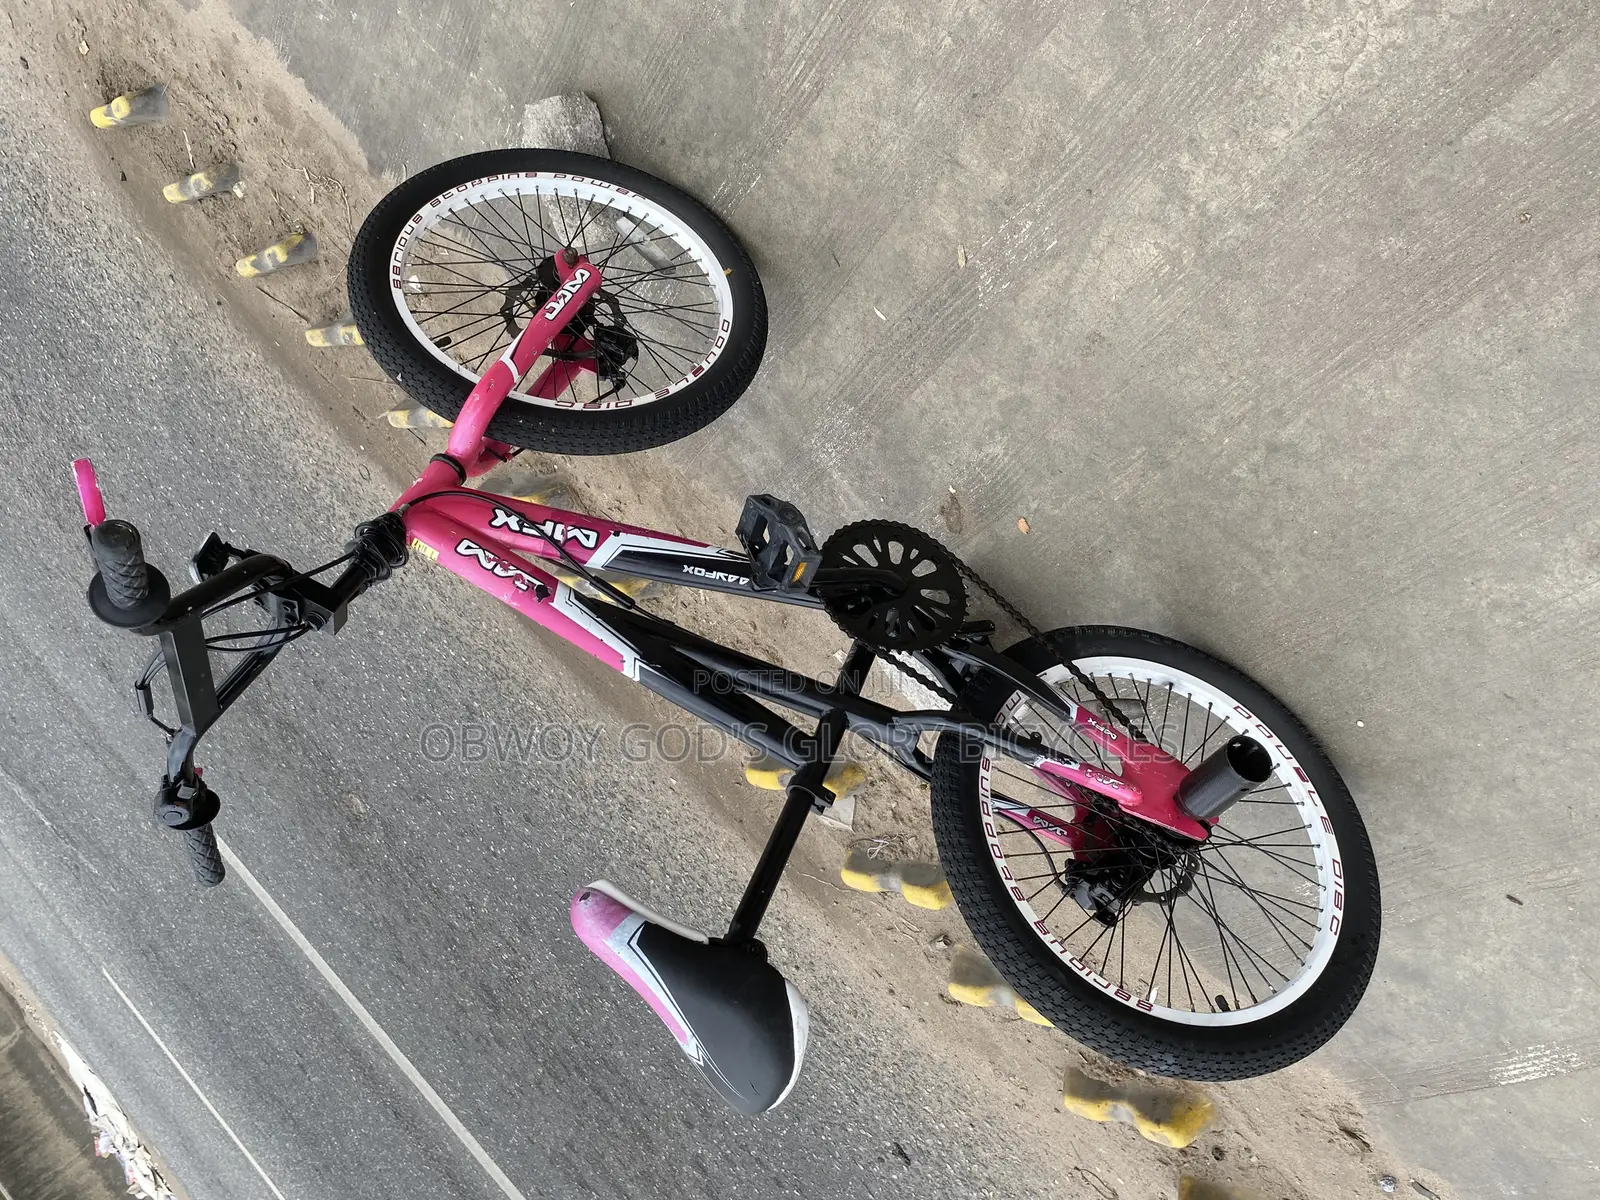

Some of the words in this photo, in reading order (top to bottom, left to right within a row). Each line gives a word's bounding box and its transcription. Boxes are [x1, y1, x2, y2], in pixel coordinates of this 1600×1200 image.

[655, 319, 730, 399] DOUBLE
[555, 400, 633, 409] DISC
[489, 507, 600, 549] MFX
[1233, 705, 1334, 835] DOUBLE
[1329, 857, 1344, 936] DISC
